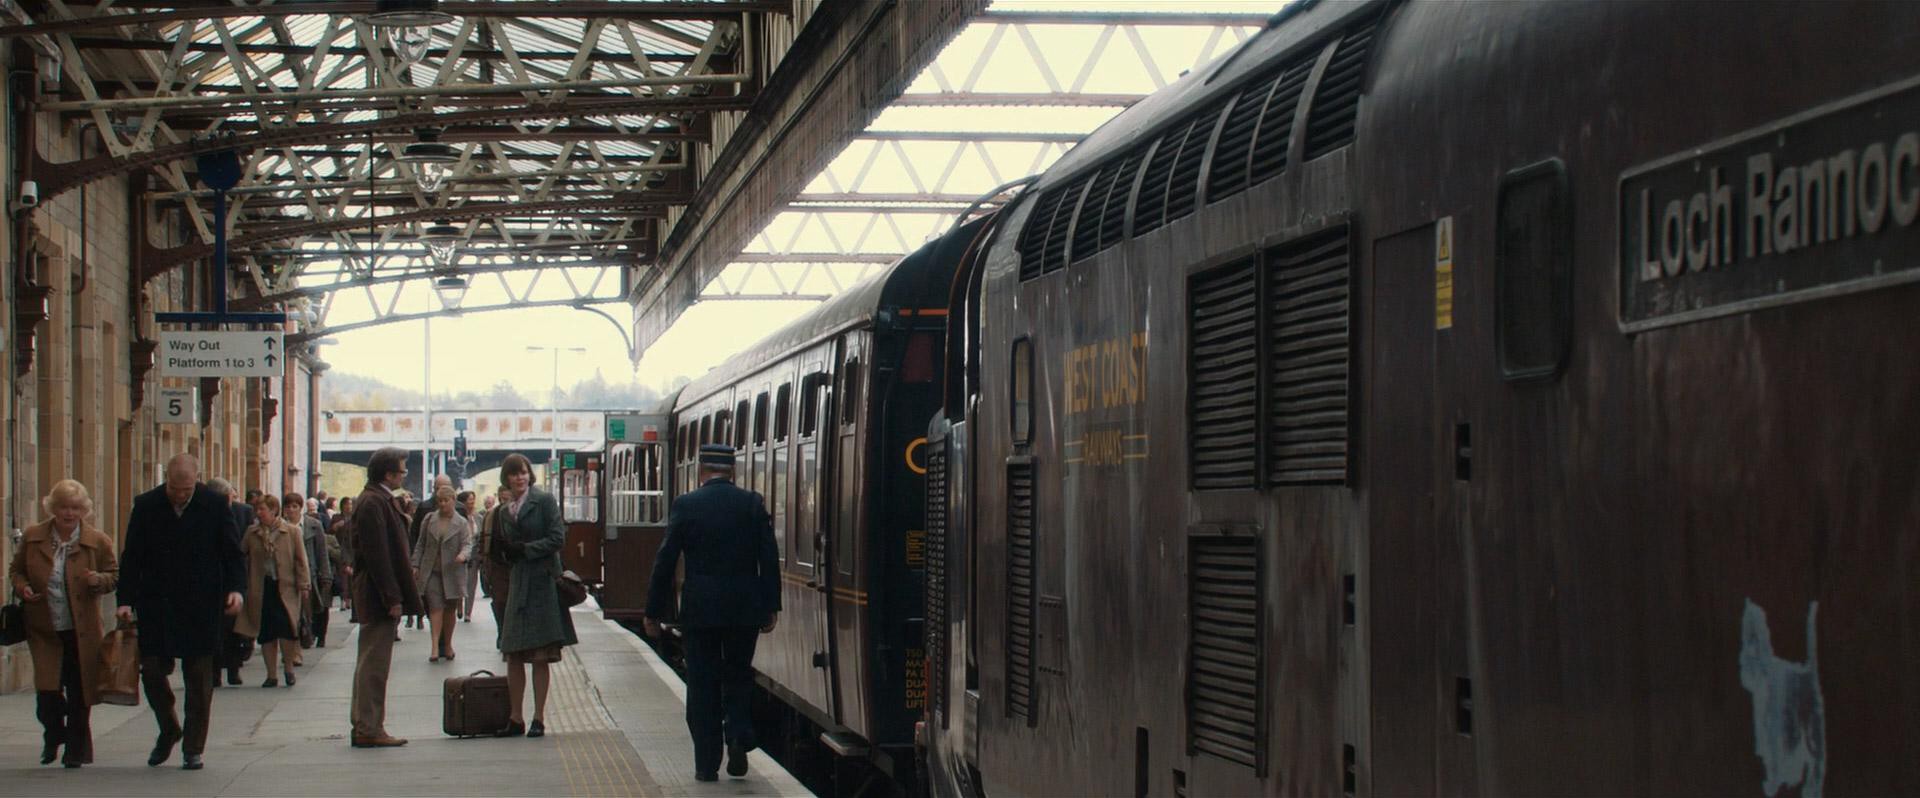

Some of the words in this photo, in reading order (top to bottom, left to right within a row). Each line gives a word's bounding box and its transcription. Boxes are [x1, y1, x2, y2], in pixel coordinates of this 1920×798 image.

[1640, 166, 1732, 282] Loch
[1746, 131, 1920, 258] Rannoc
[168, 340, 195, 352] Way
[198, 340, 220, 351] Out
[168, 357, 221, 368] Platform
[225, 358, 230, 368] 1
[233, 358, 245, 368] to
[247, 358, 255, 368] 3
[1063, 342, 1098, 415] WEST
[1102, 332, 1147, 409] COAST
[168, 399, 182, 416] 5
[577, 541, 585, 558] 1
